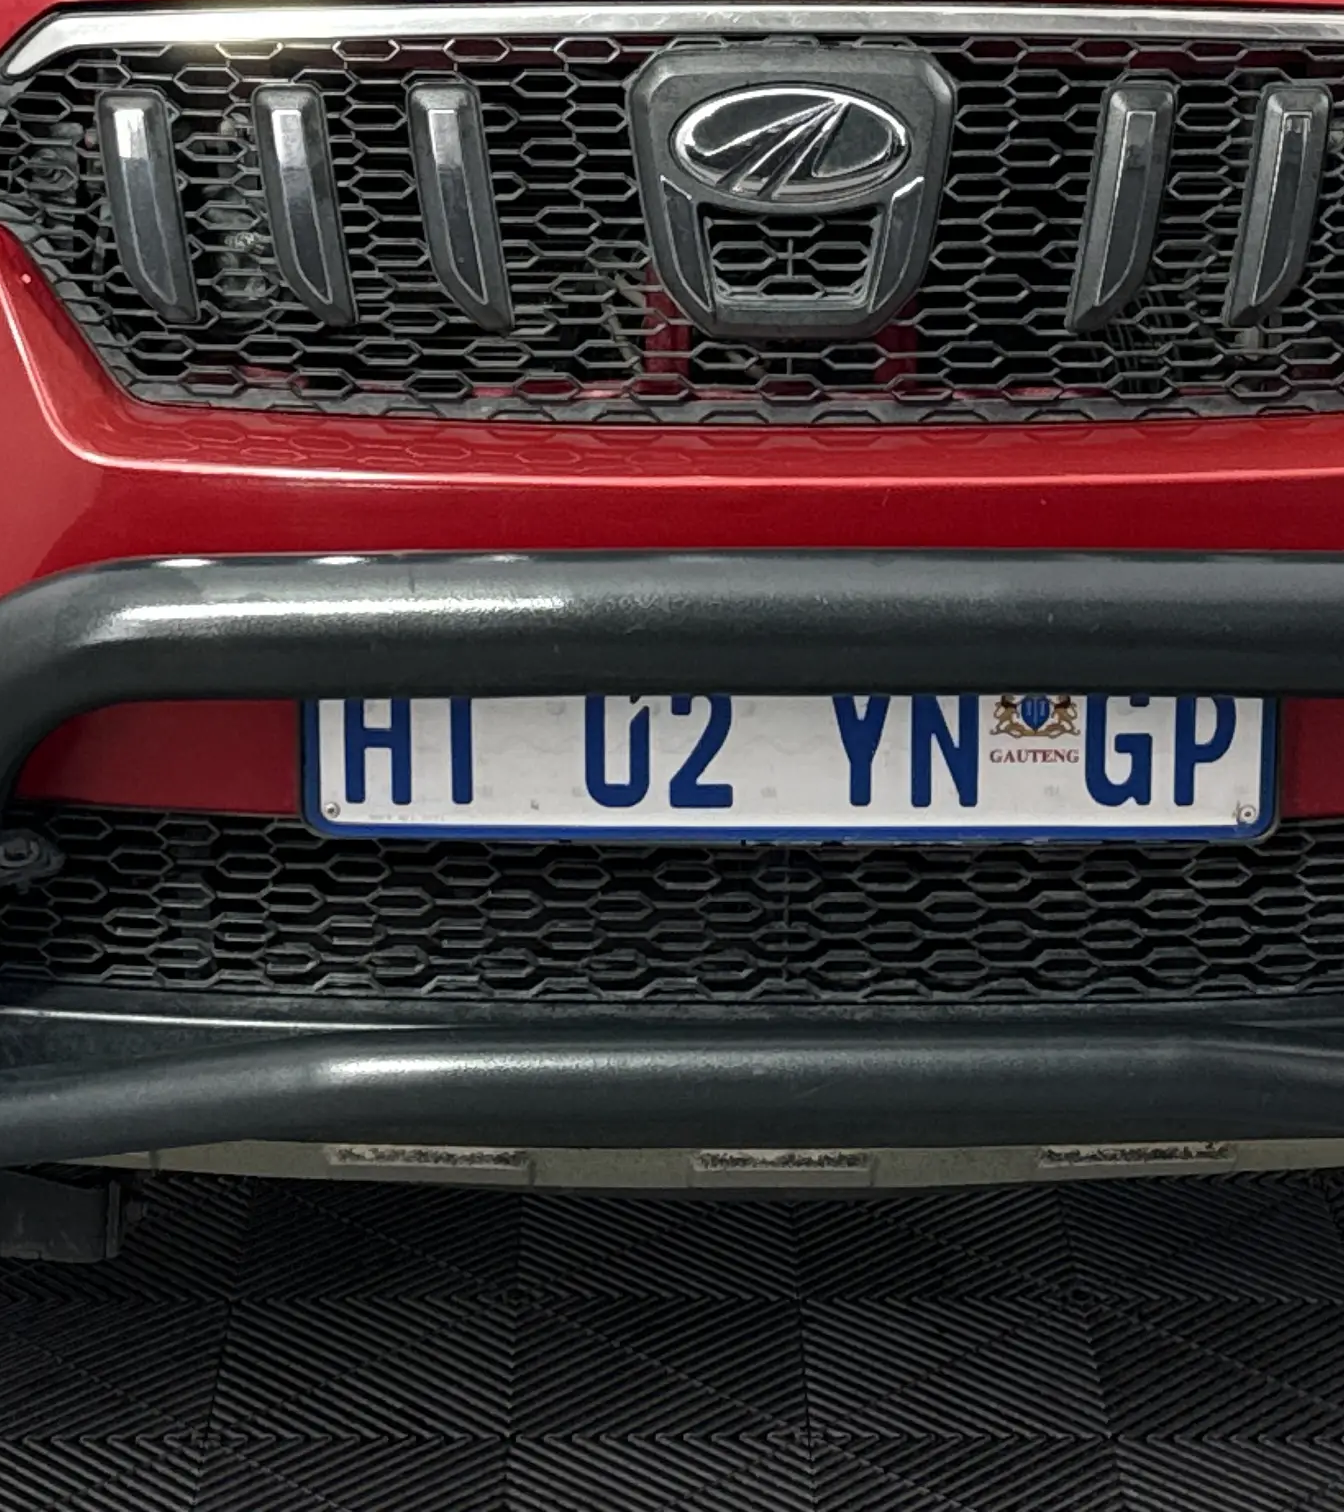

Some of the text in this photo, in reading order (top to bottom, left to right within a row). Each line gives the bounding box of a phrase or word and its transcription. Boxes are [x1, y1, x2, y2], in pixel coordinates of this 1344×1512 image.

[584, 694, 734, 809] 02
[832, 694, 980, 808] YN
[1085, 694, 1237, 807] GP
[989, 748, 1080, 764] GAUTENG
